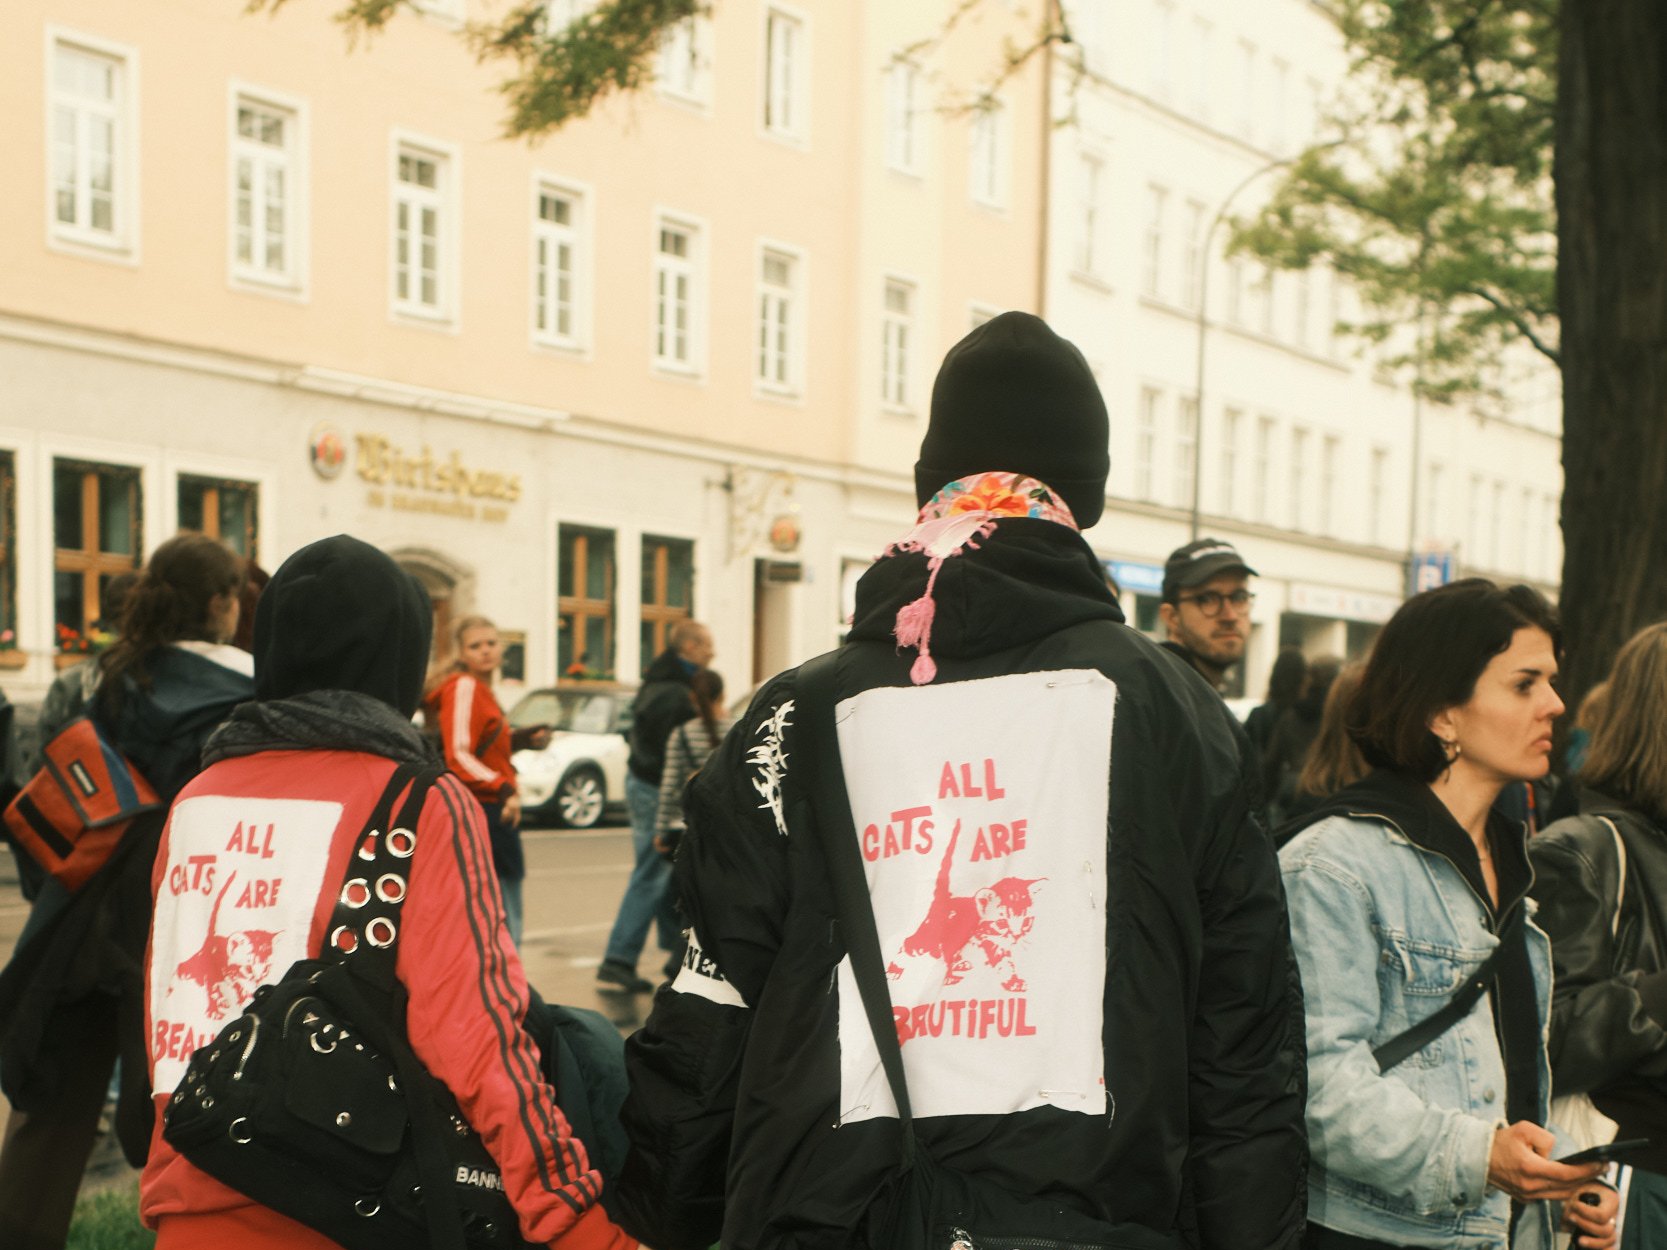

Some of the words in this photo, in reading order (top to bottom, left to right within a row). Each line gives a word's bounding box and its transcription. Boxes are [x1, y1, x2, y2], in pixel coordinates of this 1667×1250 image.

[937, 758, 1006, 801] ALL
[225, 820, 276, 859] ALL
[862, 805, 935, 863] CATS
[969, 818, 1028, 862] ARE
[169, 854, 217, 897] CATS
[234, 877, 283, 909] ARE
[455, 1165, 505, 1192] BANN
